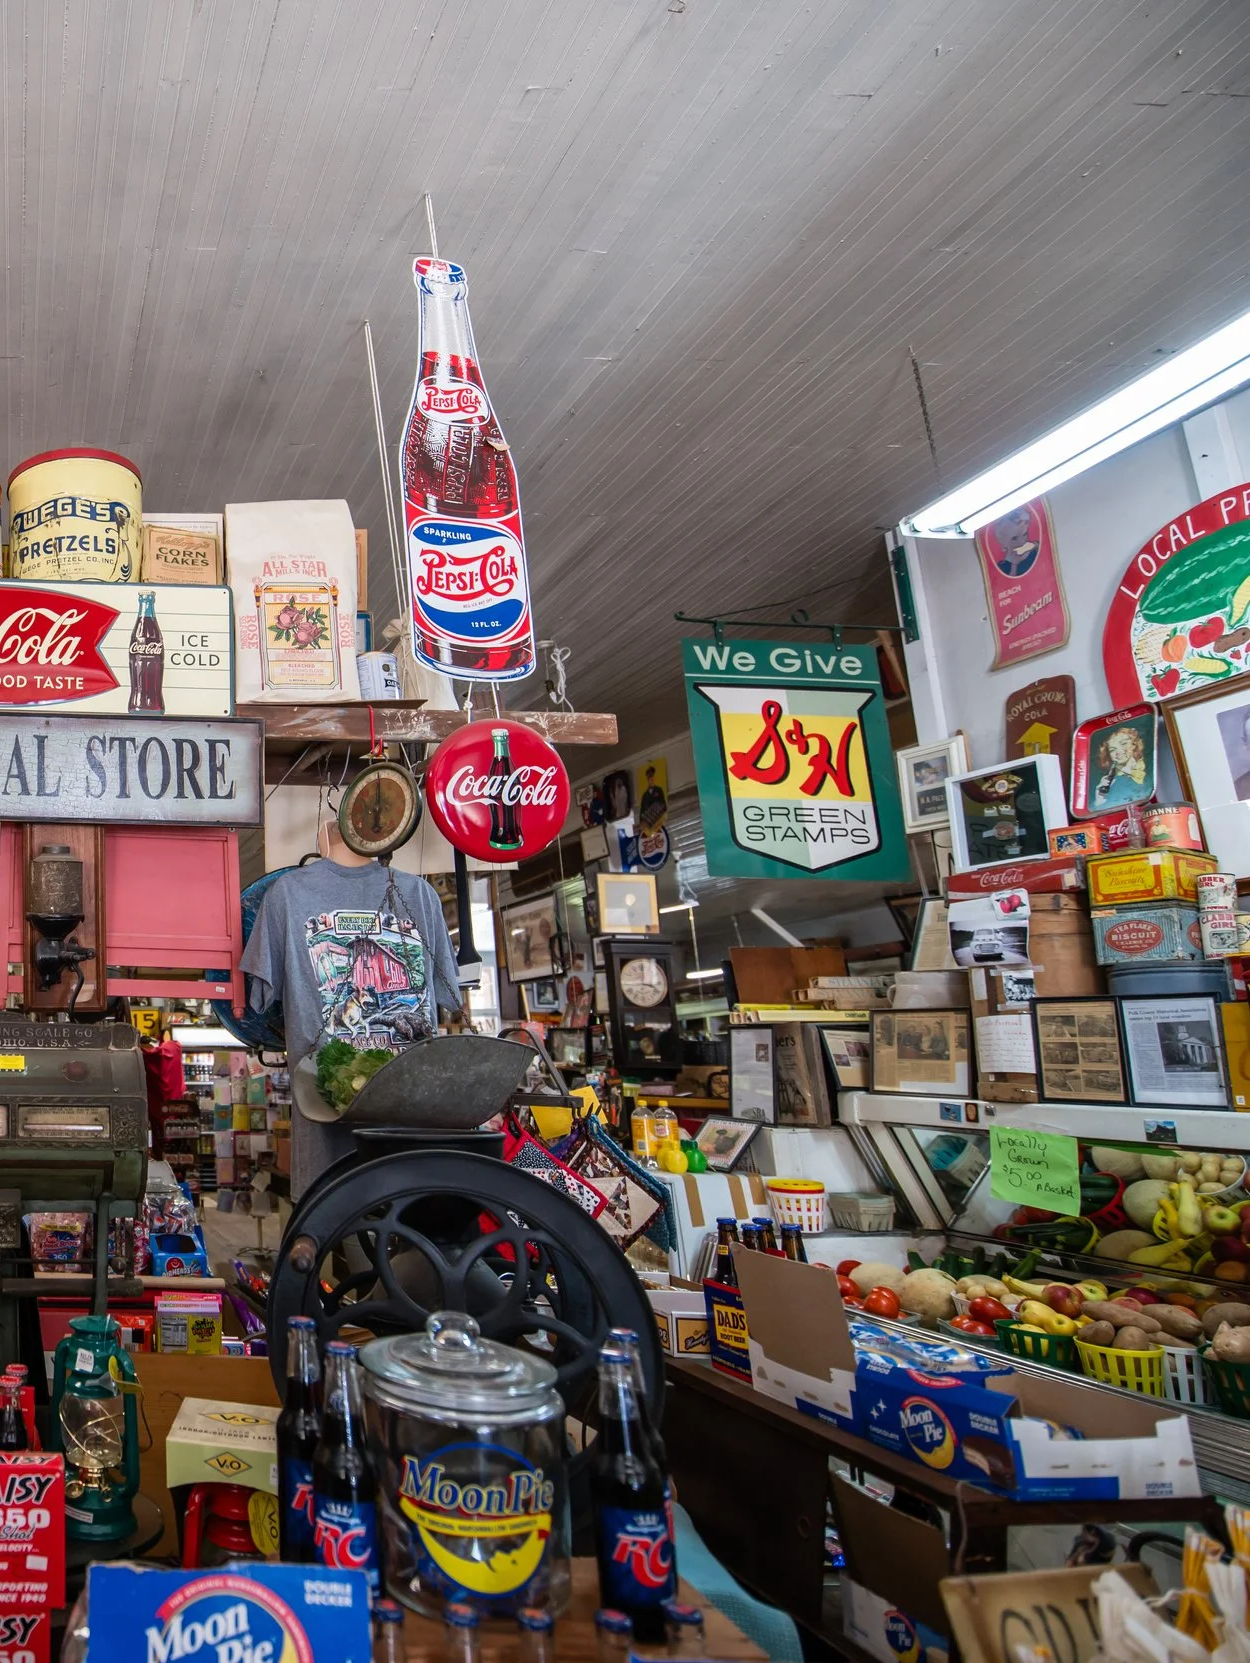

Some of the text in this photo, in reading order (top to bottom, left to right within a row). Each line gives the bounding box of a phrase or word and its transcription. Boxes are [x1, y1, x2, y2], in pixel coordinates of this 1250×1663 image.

[22, 498, 111, 530] WEGE'S
[423, 526, 472, 540] SPARKLING
[18, 535, 116, 564] PRETZELS
[158, 547, 207, 559] CORN
[1120, 515, 1206, 600] LOCAL
[22, 562, 41, 574] WEGE
[46, 556, 82, 565] PRETZEL
[155, 553, 210, 567] FLAKES
[262, 560, 327, 578] ALL STAR
[273, 594, 322, 602] ROSE
[1002, 592, 1053, 635] Sunbeam
[247, 615, 259, 649] ROSE
[340, 613, 350, 648] ROSE
[129, 641, 163, 656] Coca-Cola
[181, 635, 209, 648] ICE
[170, 652, 220, 667] COLD
[694, 645, 862, 676] We Give
[34, 675, 84, 690] TASTE
[1007, 696, 1034, 722] ROYAL
[1024, 707, 1048, 721] COLA
[86, 735, 235, 800] STORE
[446, 765, 557, 807] Coca-Cola
[743, 805, 865, 825] GREEN
[746, 825, 870, 844] STAMPS
[1111, 932, 1156, 941] BISCUIT
[1114, 923, 1153, 934] TEA FLAKE
[26, 1027, 70, 1037] SCALE
[995, 1134, 1047, 1157] Locally
[1036, 1184, 1043, 1192] A
[716, 1310, 746, 1331] DAD'S
[720, 1332, 746, 1344] ROOT BEER
[899, 1408, 932, 1429] Moon
[923, 1424, 943, 1443] Pie
[428, 1520, 454, 1531] ORIGINAL
[314, 1519, 372, 1570] RC
[613, 1533, 671, 1589] RC
[184, 1578, 224, 1597] ORIGINAL
[303, 1579, 353, 1595] DOUBLE
[304, 1593, 353, 1608] DECKER
[146, 1603, 249, 1663] Moon
[884, 1618, 907, 1635] Moon
[217, 1635, 276, 1663] Pie
[898, 1632, 912, 1648] Pie
